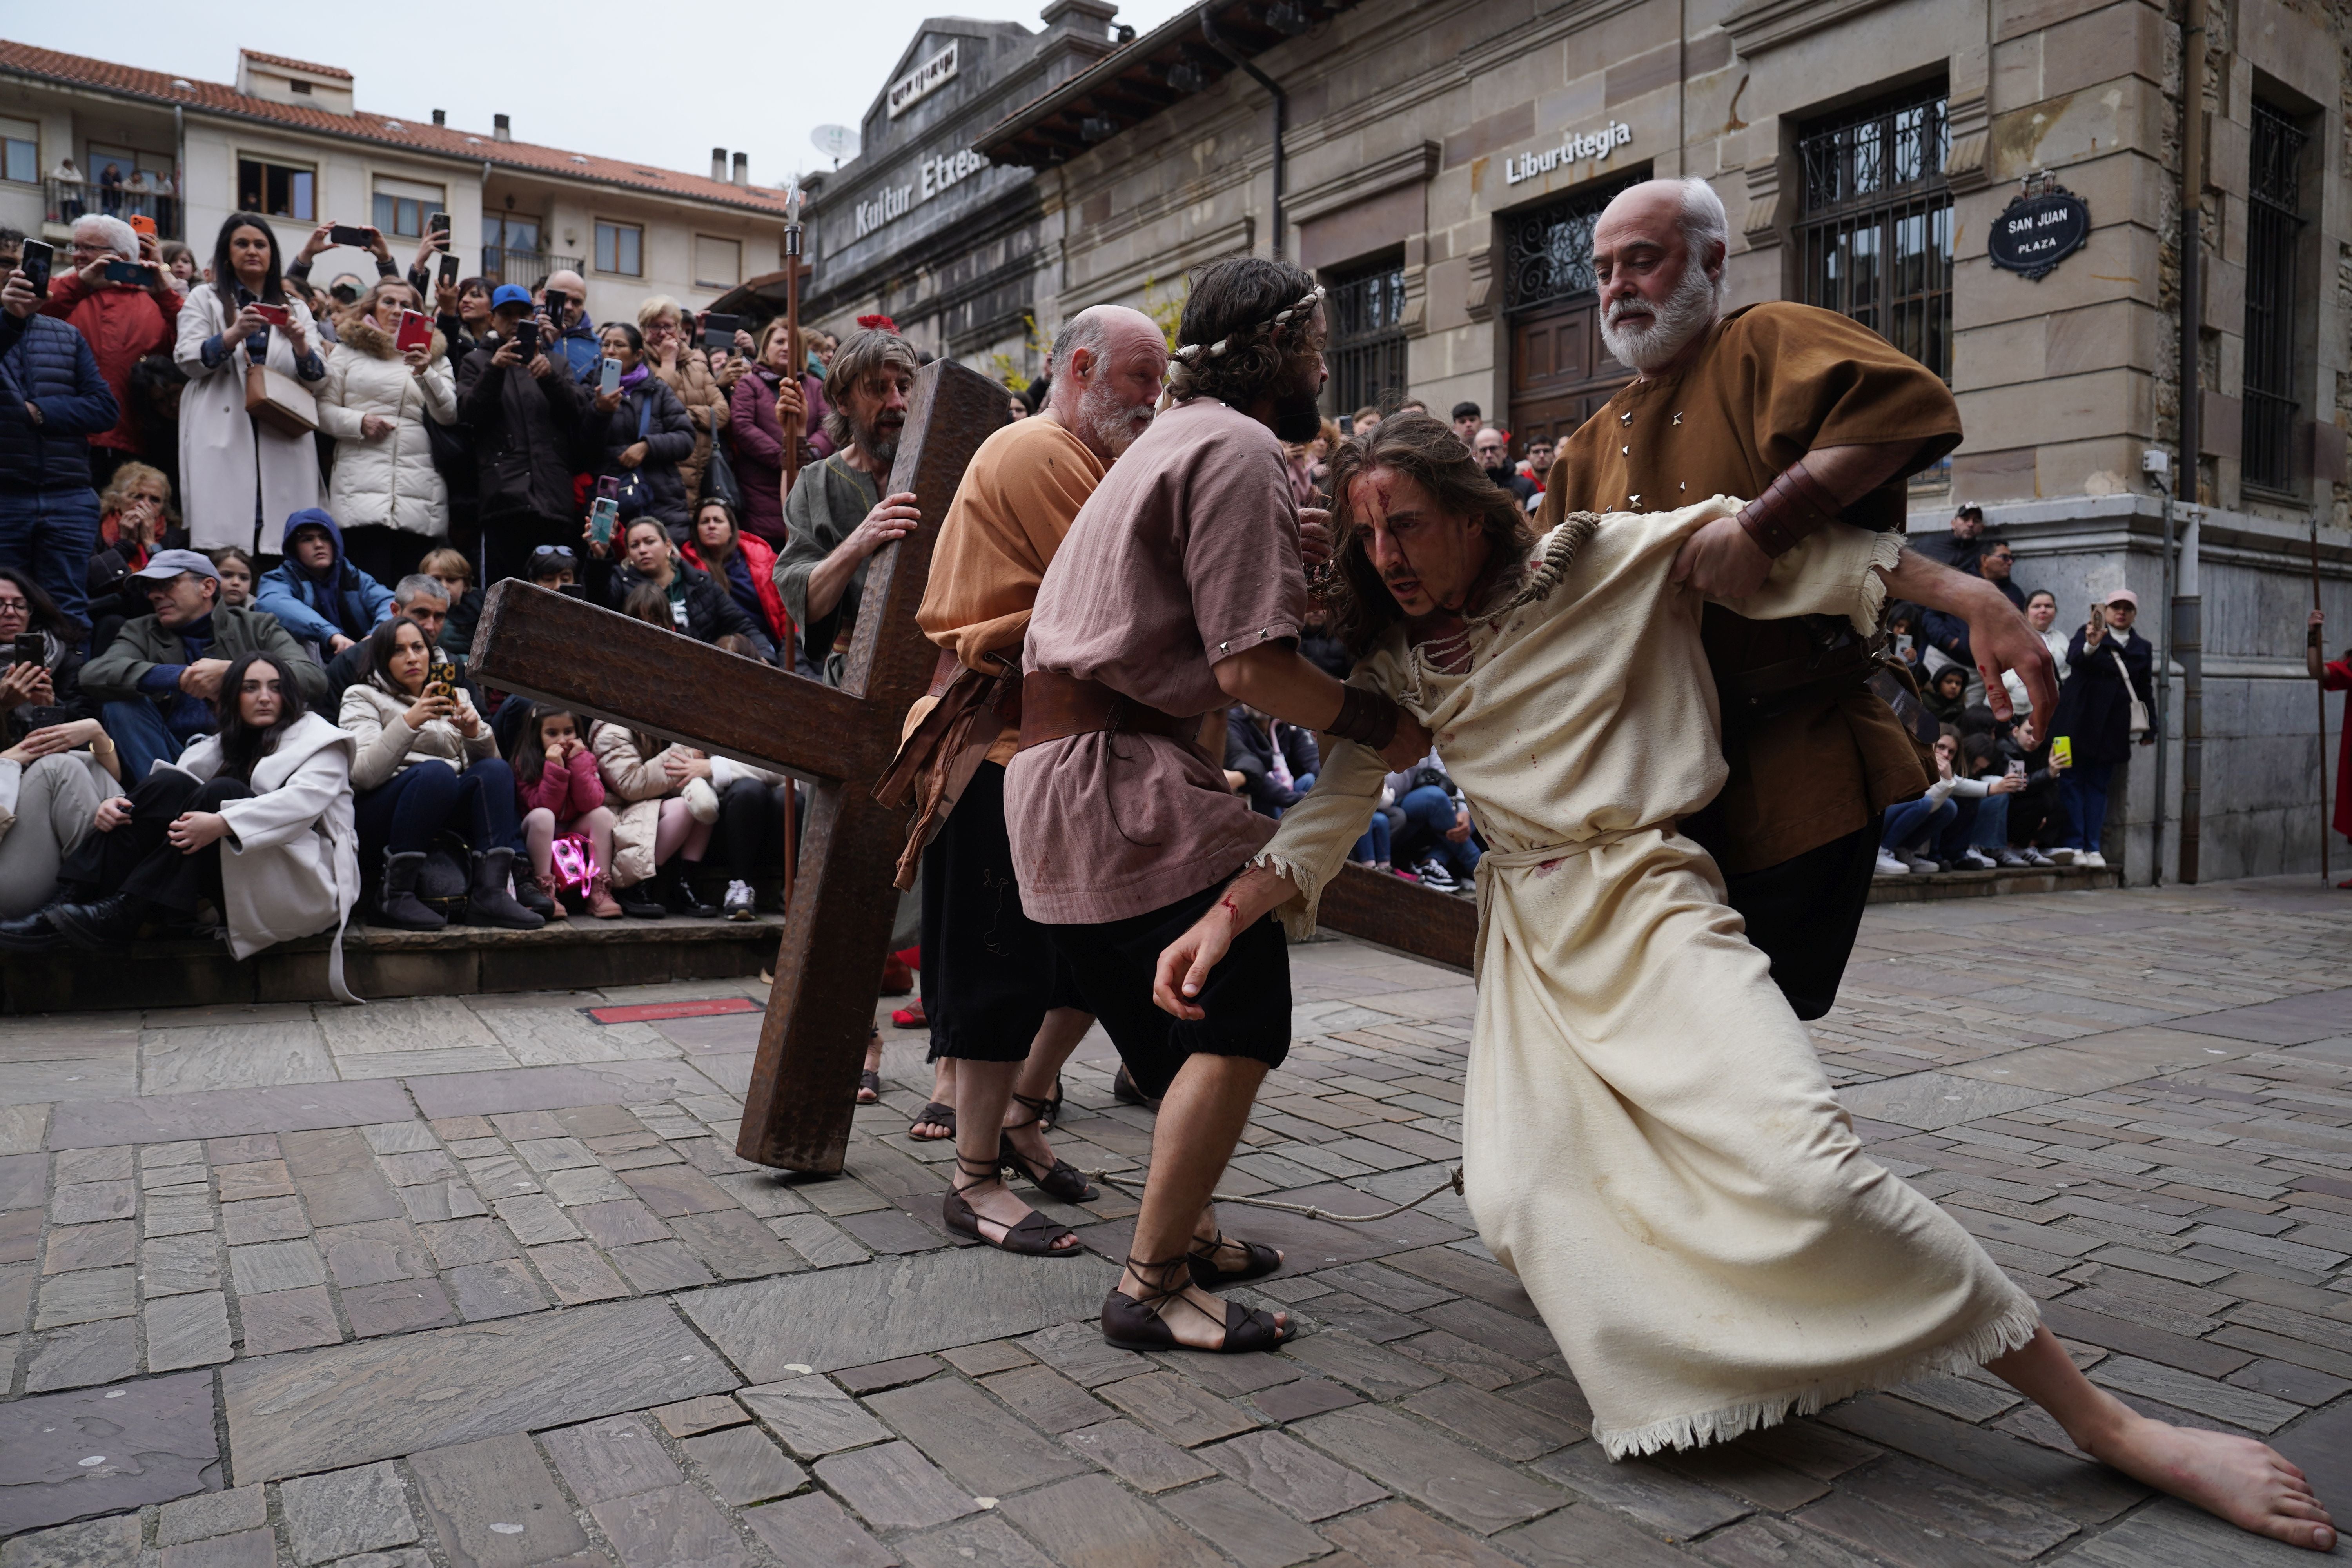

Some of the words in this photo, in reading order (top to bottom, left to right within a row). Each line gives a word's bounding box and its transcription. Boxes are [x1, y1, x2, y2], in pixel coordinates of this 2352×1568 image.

[1506, 120, 1631, 184] Liburutegia
[855, 183, 913, 238] Kultur
[922, 147, 981, 200] Etxea
[2008, 216, 2033, 234] SAN
[2037, 207, 2068, 227] JUAN
[2018, 237, 2057, 254] PLAZA
